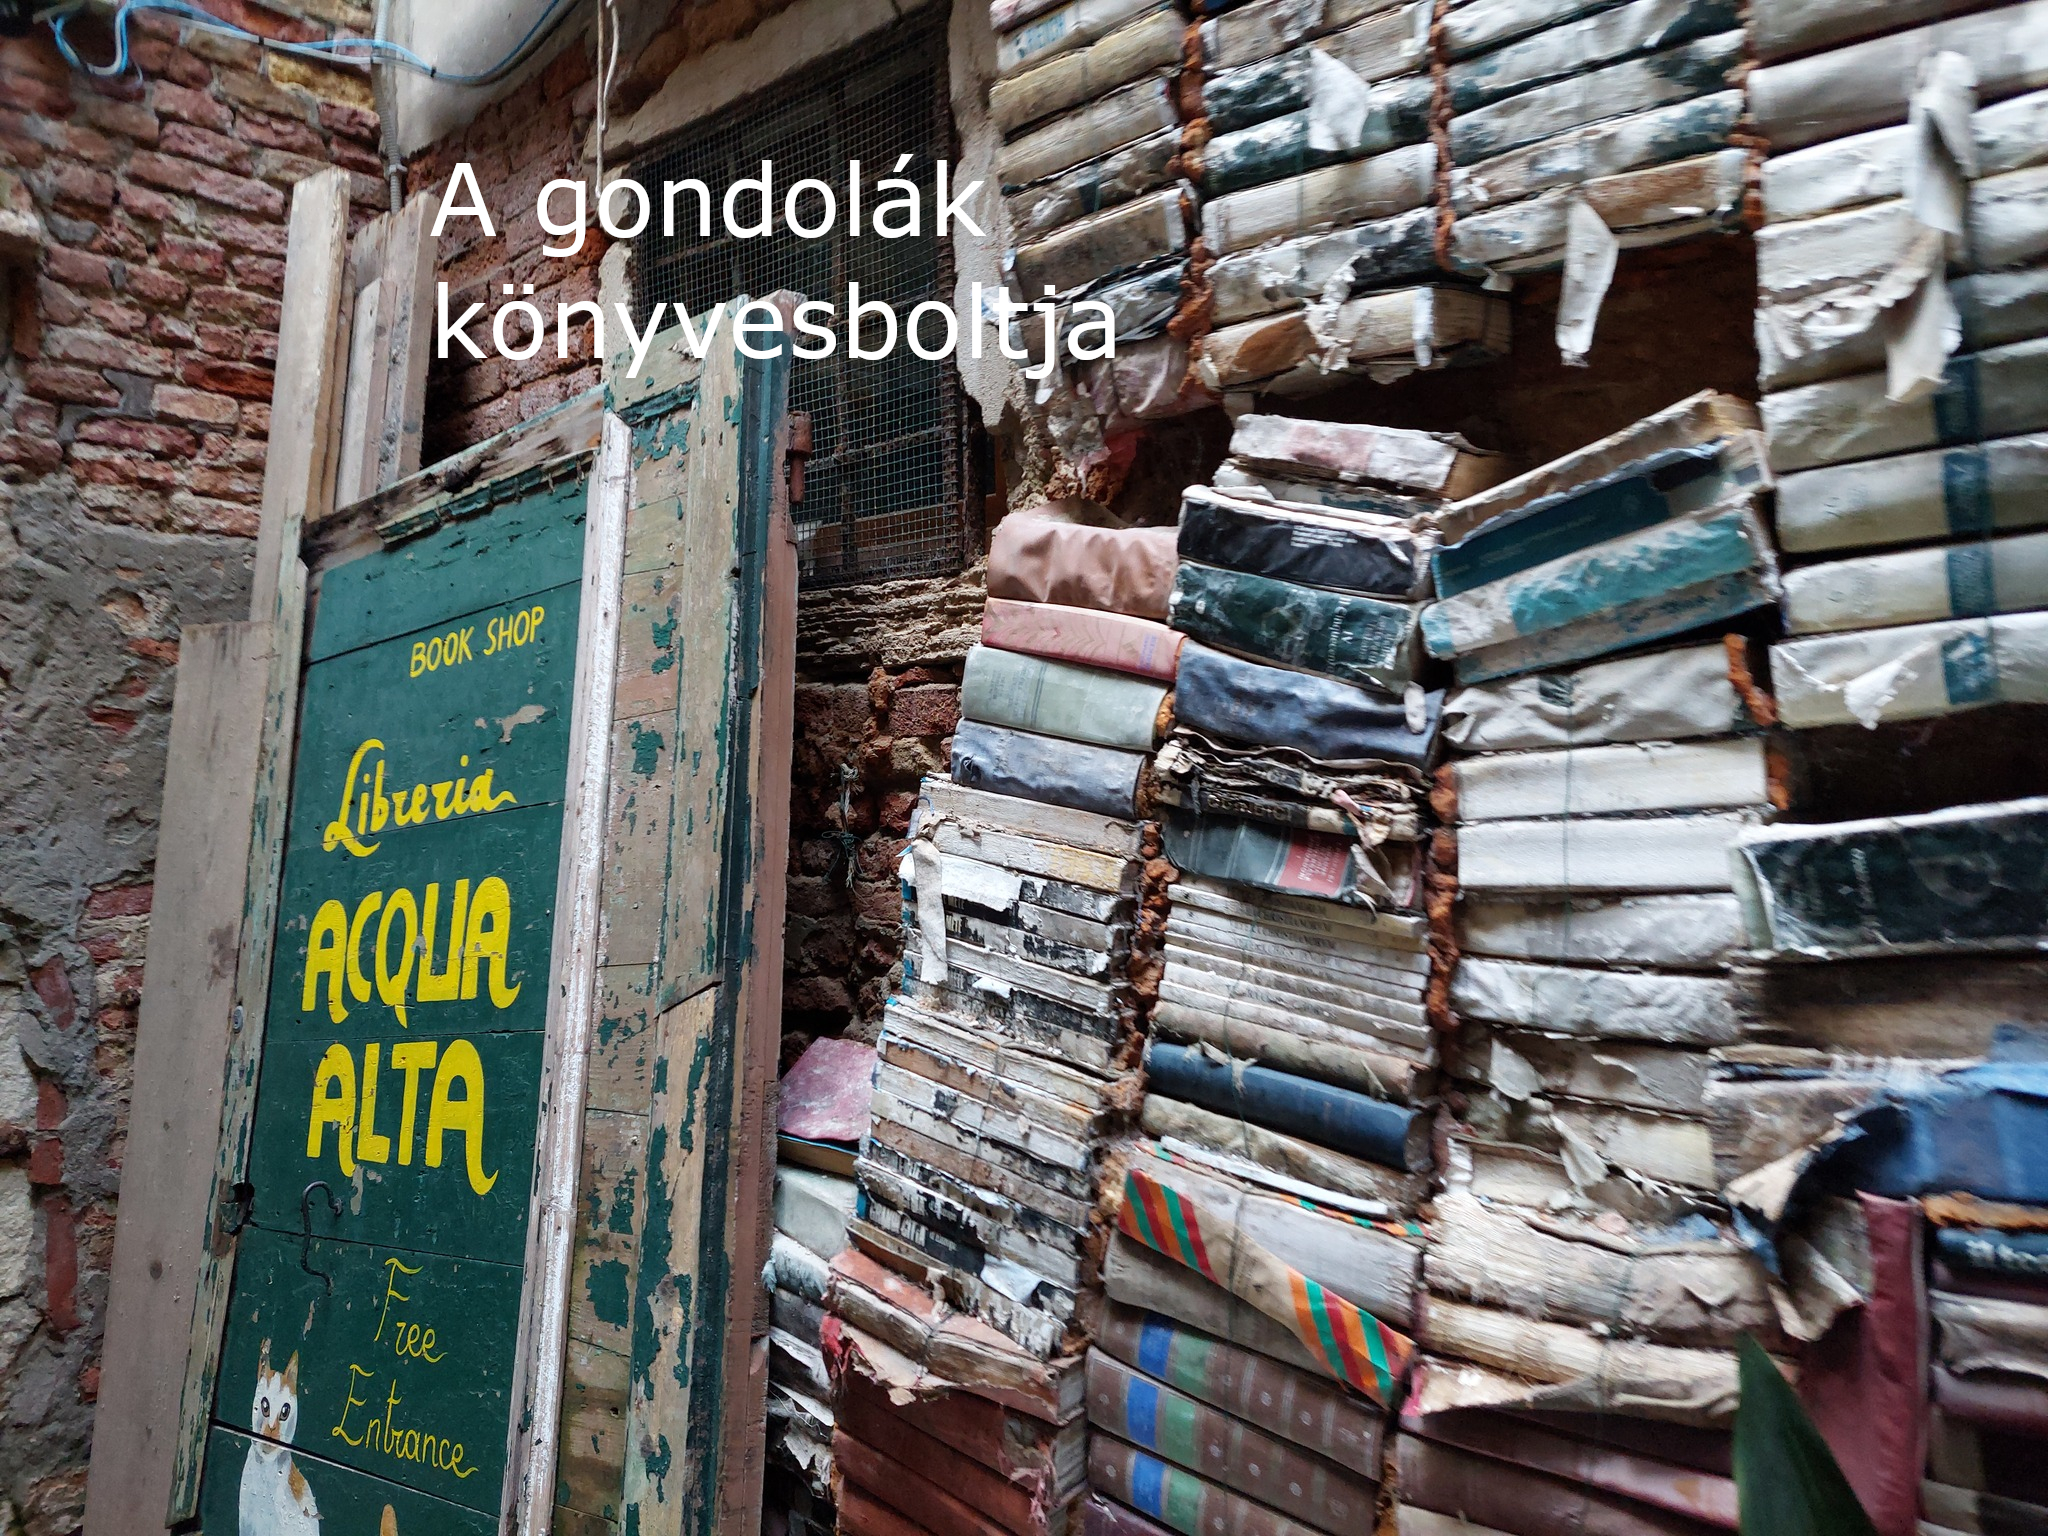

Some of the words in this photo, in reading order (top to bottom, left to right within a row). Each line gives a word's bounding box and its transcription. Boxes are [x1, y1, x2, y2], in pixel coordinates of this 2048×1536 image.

[409, 627, 474, 678] BOOK
[483, 605, 545, 656] SHOP
[322, 738, 518, 858] Libreria
[301, 876, 522, 1028] ACQUA
[306, 1038, 499, 1196] ALTA
[374, 1257, 448, 1363] Free
[331, 1363, 479, 1479] Entrance
